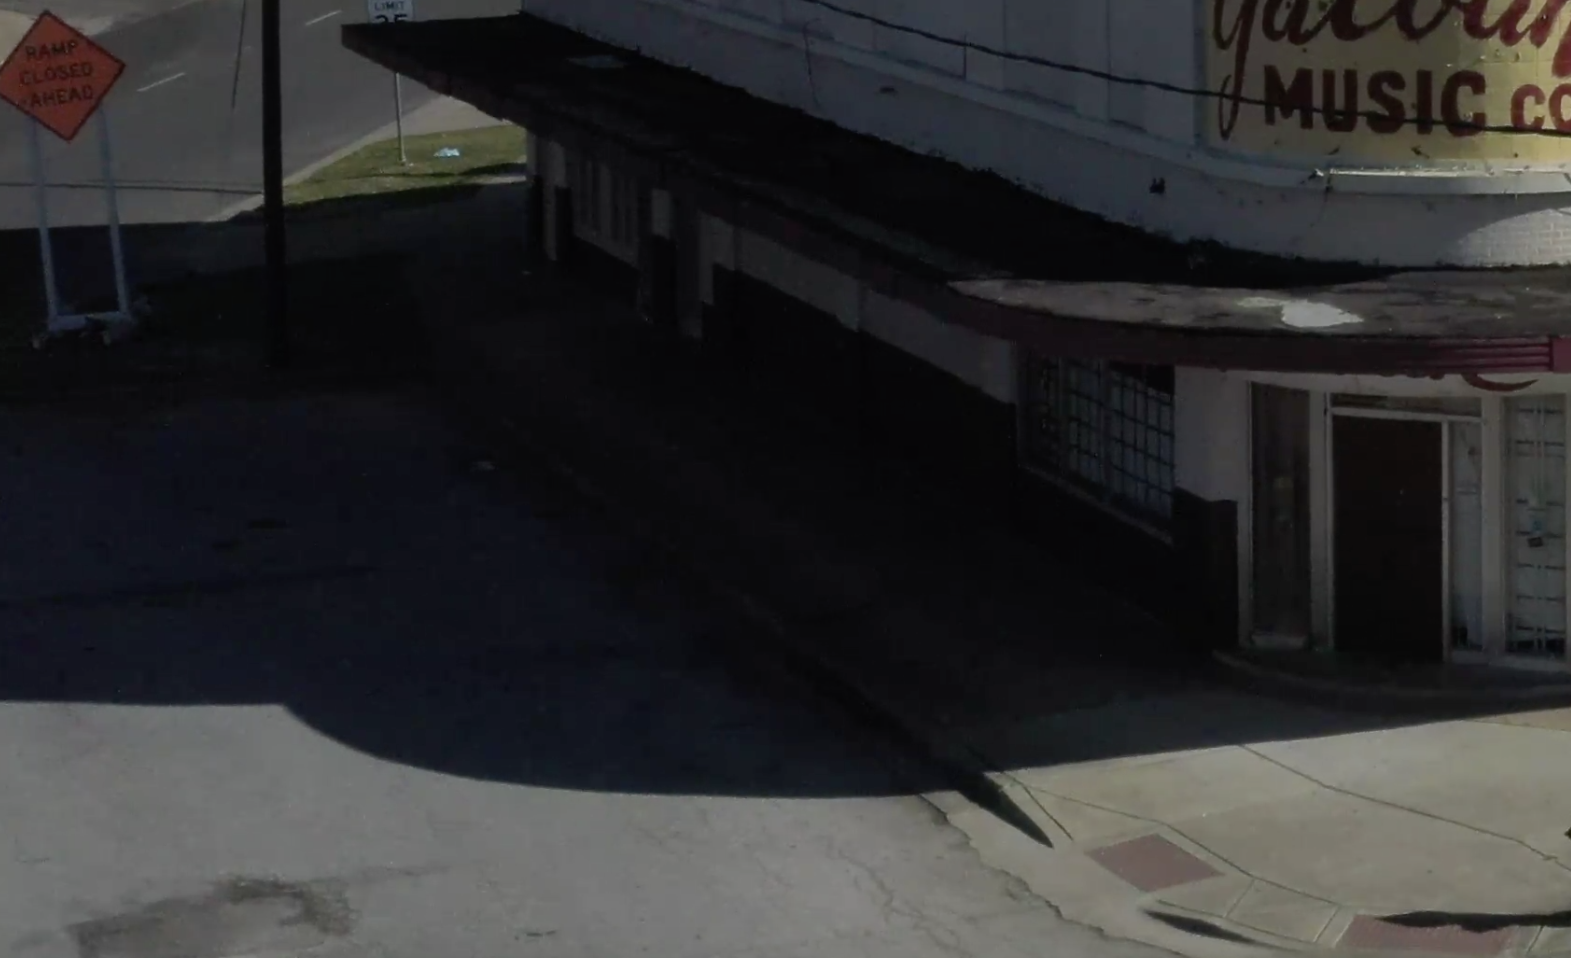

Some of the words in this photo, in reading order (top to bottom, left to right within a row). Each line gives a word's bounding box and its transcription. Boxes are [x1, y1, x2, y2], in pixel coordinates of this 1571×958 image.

[374, 1, 405, 11] LIMIT
[25, 40, 78, 60] RAMP
[20, 62, 94, 85] CLOSED
[30, 84, 94, 107] AHEAD
[1263, 64, 1487, 138] MUSIC
